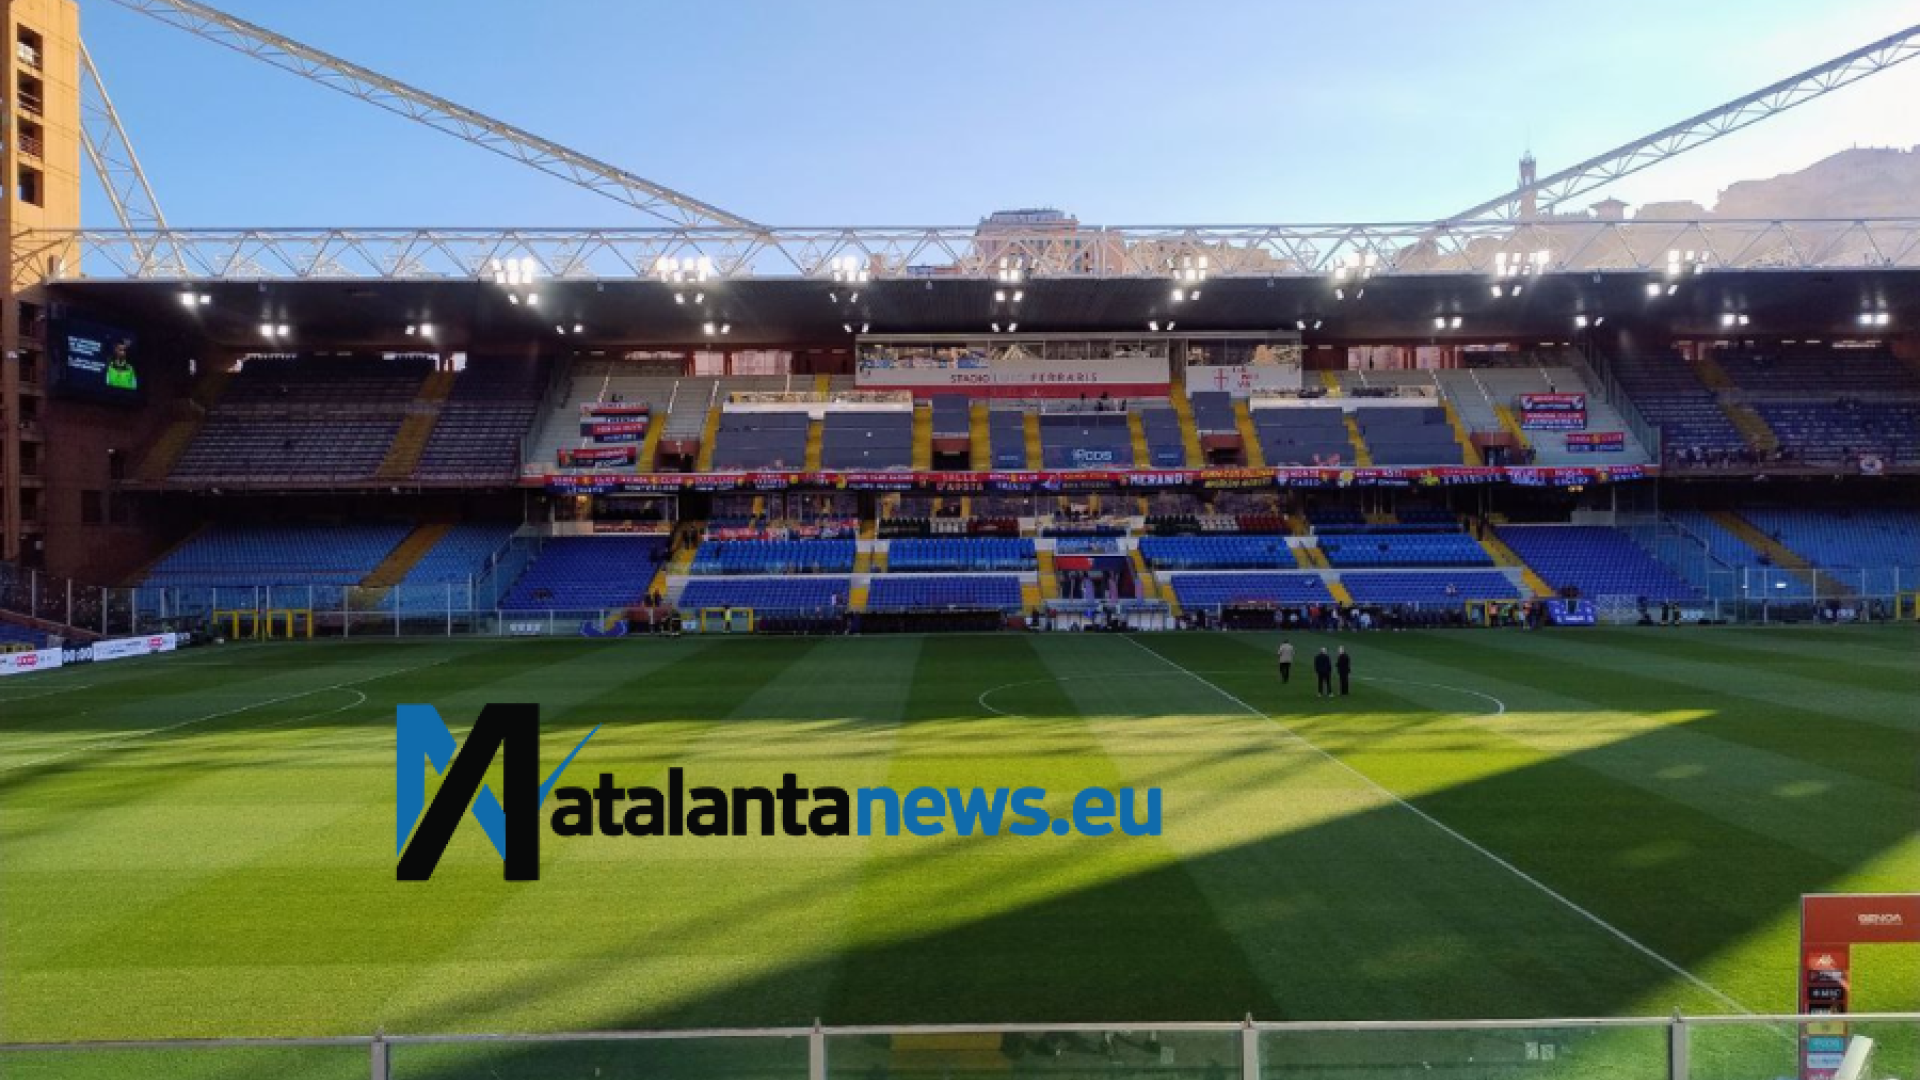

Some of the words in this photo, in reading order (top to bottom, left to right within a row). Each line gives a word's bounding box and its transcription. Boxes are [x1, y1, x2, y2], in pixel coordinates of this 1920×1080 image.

[950, 374, 990, 383] STADIO
[1030, 372, 1097, 382] FERRARIS
[1130, 473, 1183, 486] MERANO
[1857, 913, 1903, 926] GENOA
